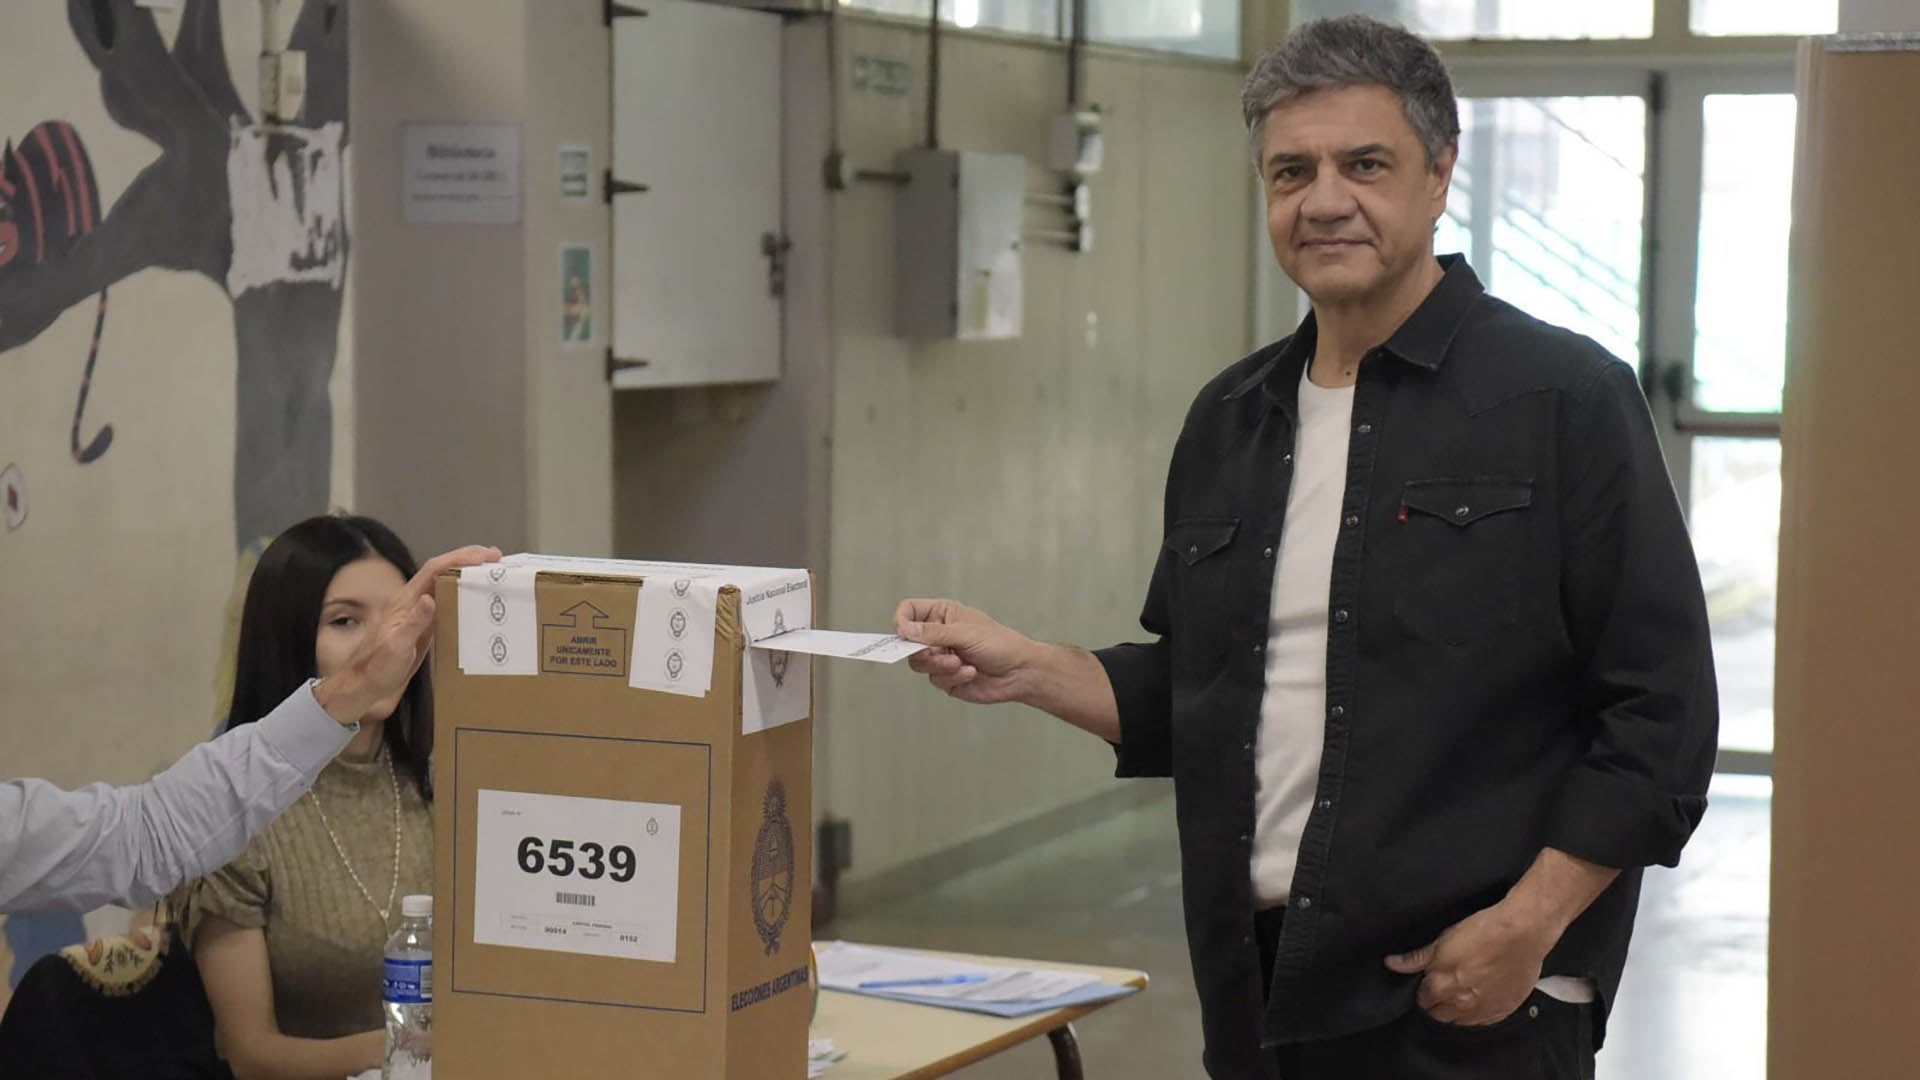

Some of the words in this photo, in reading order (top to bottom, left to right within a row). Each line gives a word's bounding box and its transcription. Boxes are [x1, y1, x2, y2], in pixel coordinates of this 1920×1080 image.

[570, 636, 598, 644] ABRIR
[550, 656, 568, 664] POR
[570, 657, 591, 666] ESTE
[593, 659, 617, 667] LADO
[517, 836, 636, 882] 6539
[731, 980, 771, 1012] ELECCIONES
[772, 965, 808, 997] ARGENTINAS
